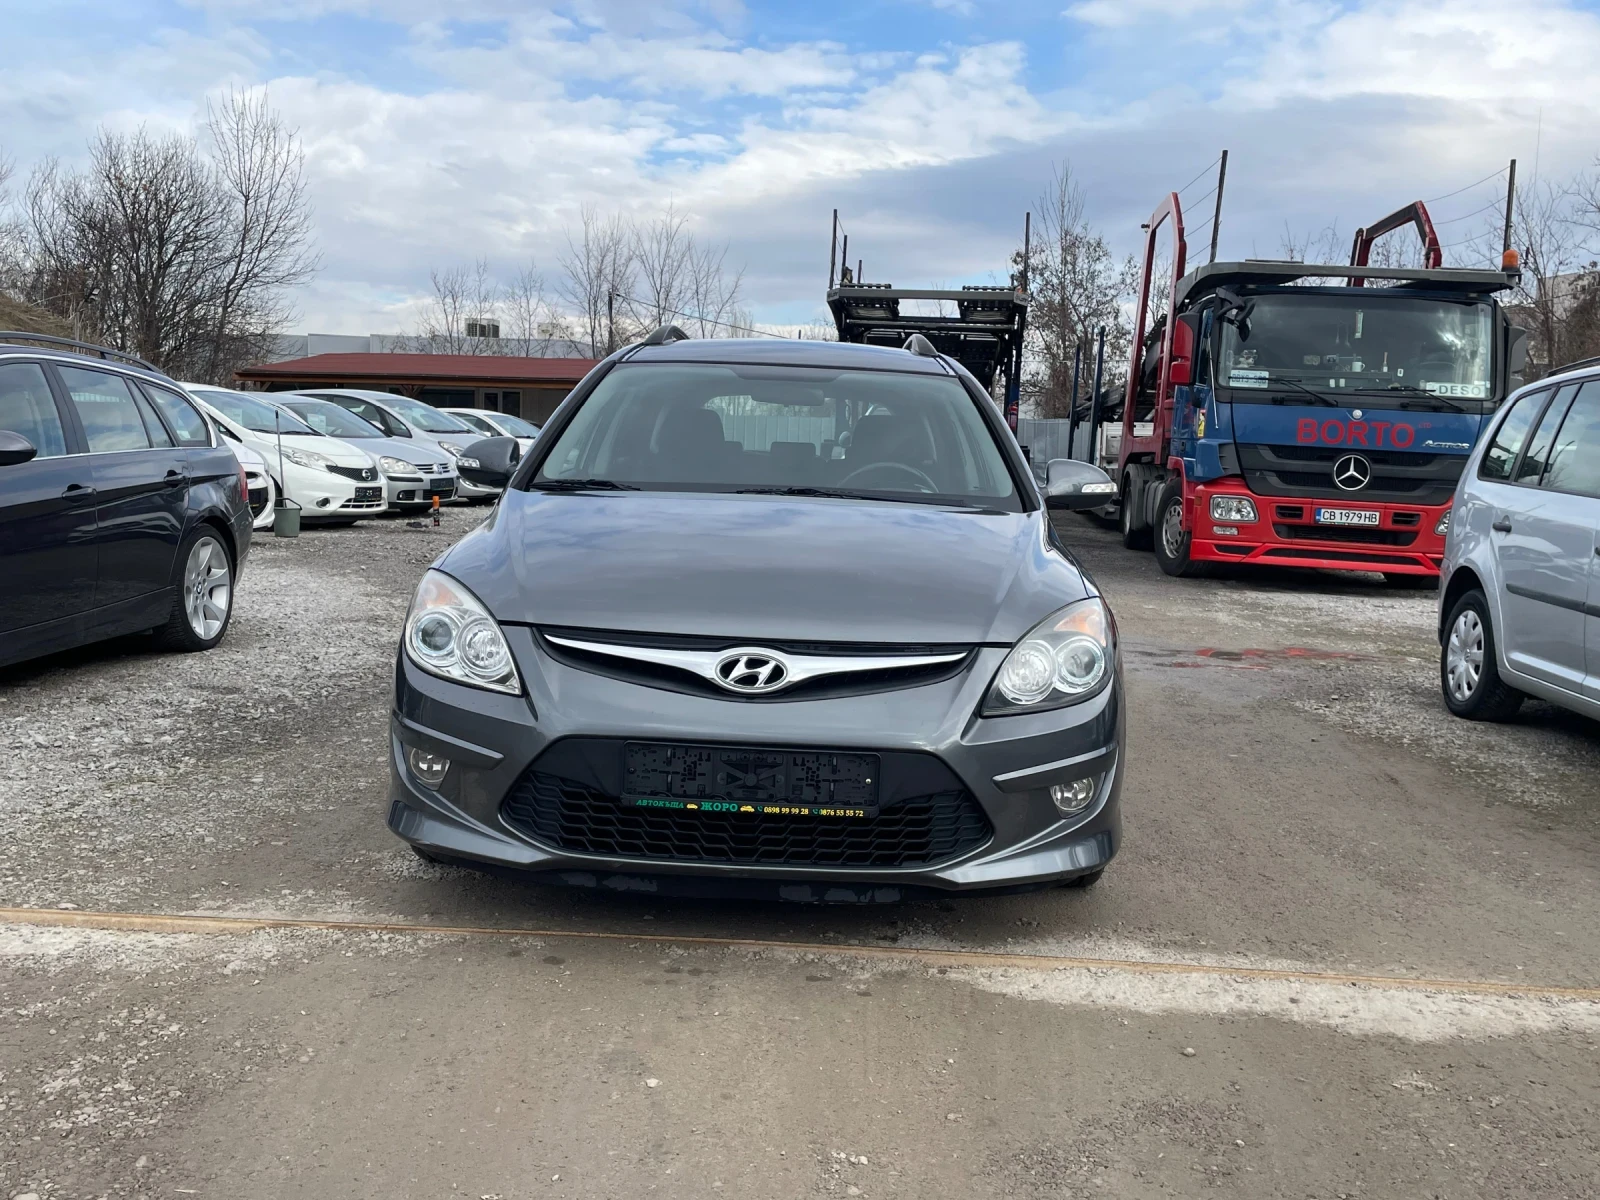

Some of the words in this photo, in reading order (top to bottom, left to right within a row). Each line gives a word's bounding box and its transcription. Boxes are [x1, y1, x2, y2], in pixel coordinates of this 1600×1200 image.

[1296, 418, 1415, 449] BORTO
[1322, 510, 1336, 521] CB
[1339, 511, 1363, 522] 1979
[1363, 513, 1378, 523] HB
[700, 801, 738, 812] ЖОРО
